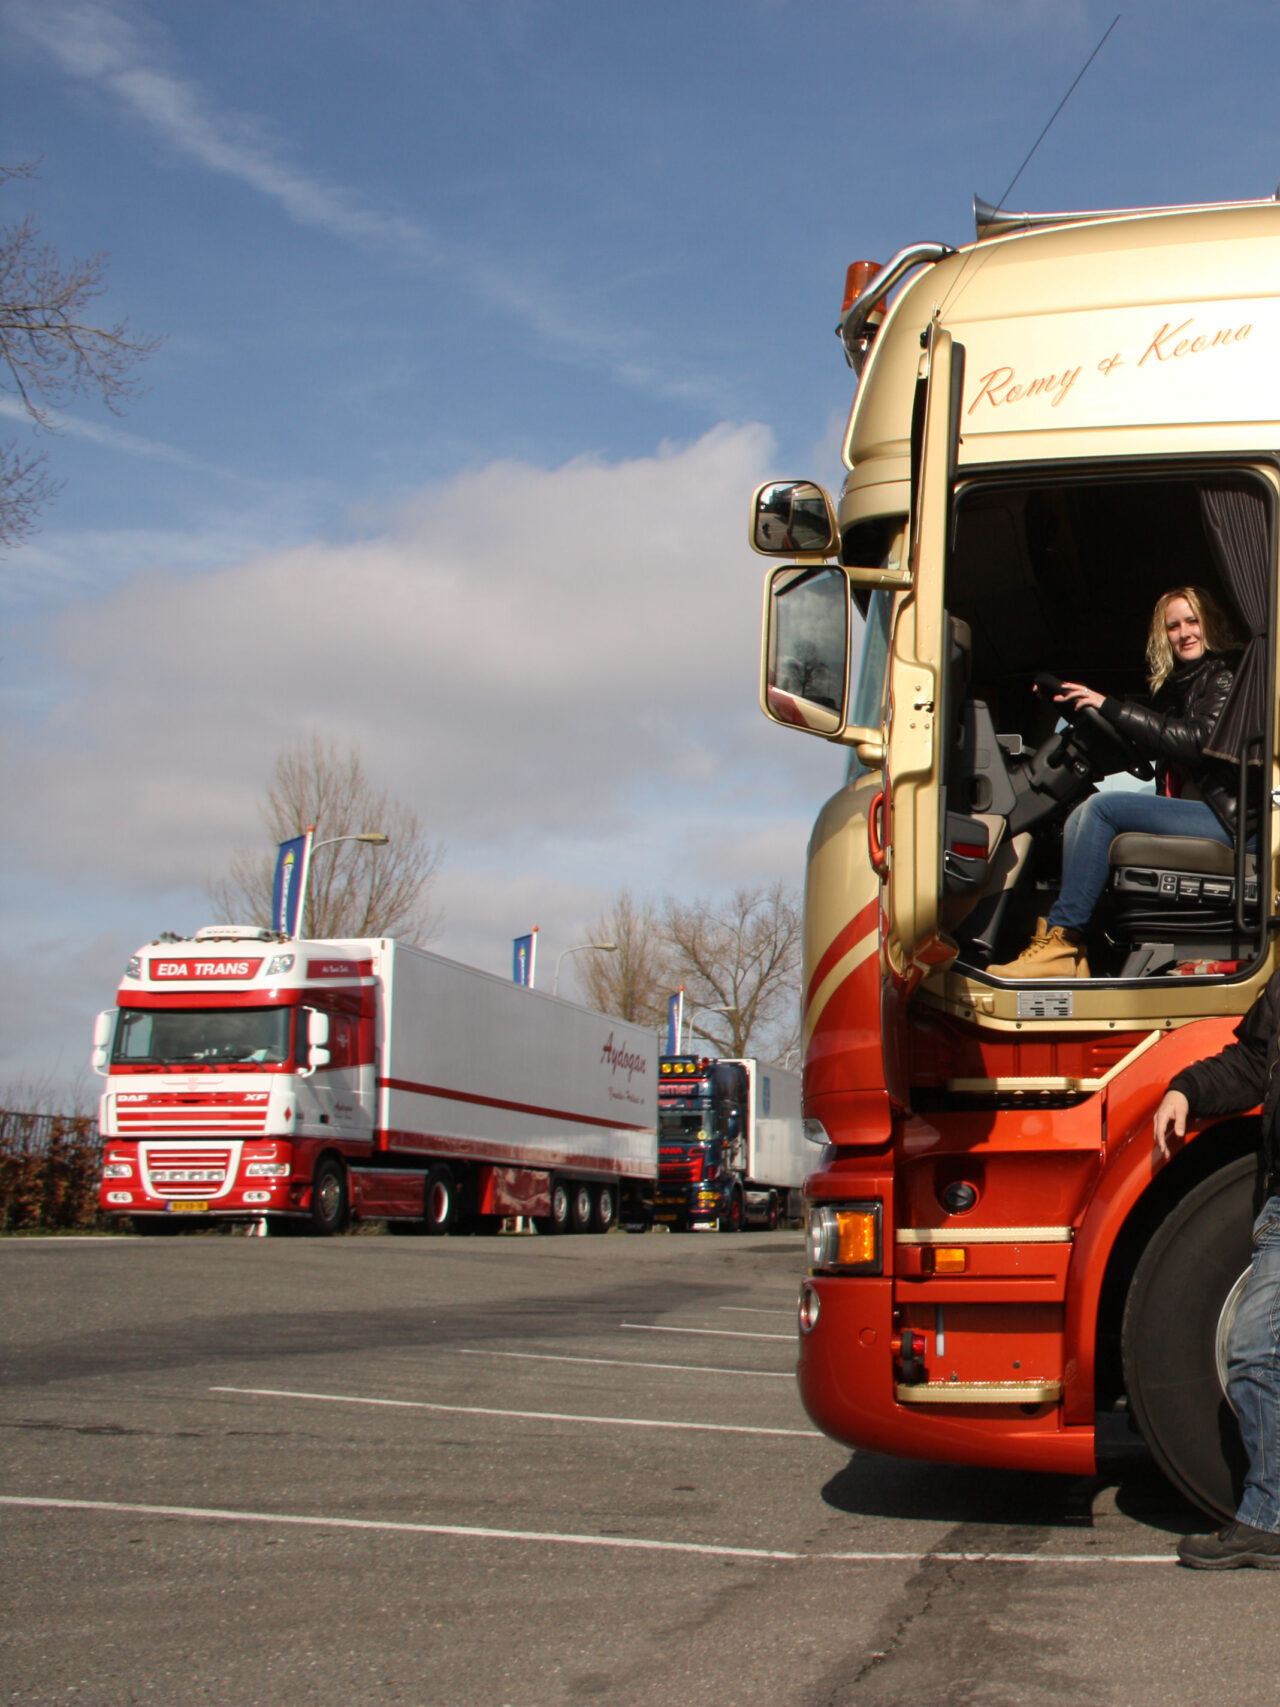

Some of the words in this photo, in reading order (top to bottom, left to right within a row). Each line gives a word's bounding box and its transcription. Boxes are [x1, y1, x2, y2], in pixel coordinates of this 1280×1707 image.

[157, 963, 188, 976] EDA
[194, 962, 249, 976] TRANS
[117, 1094, 149, 1103] DAF
[244, 1093, 268, 1102] XF
